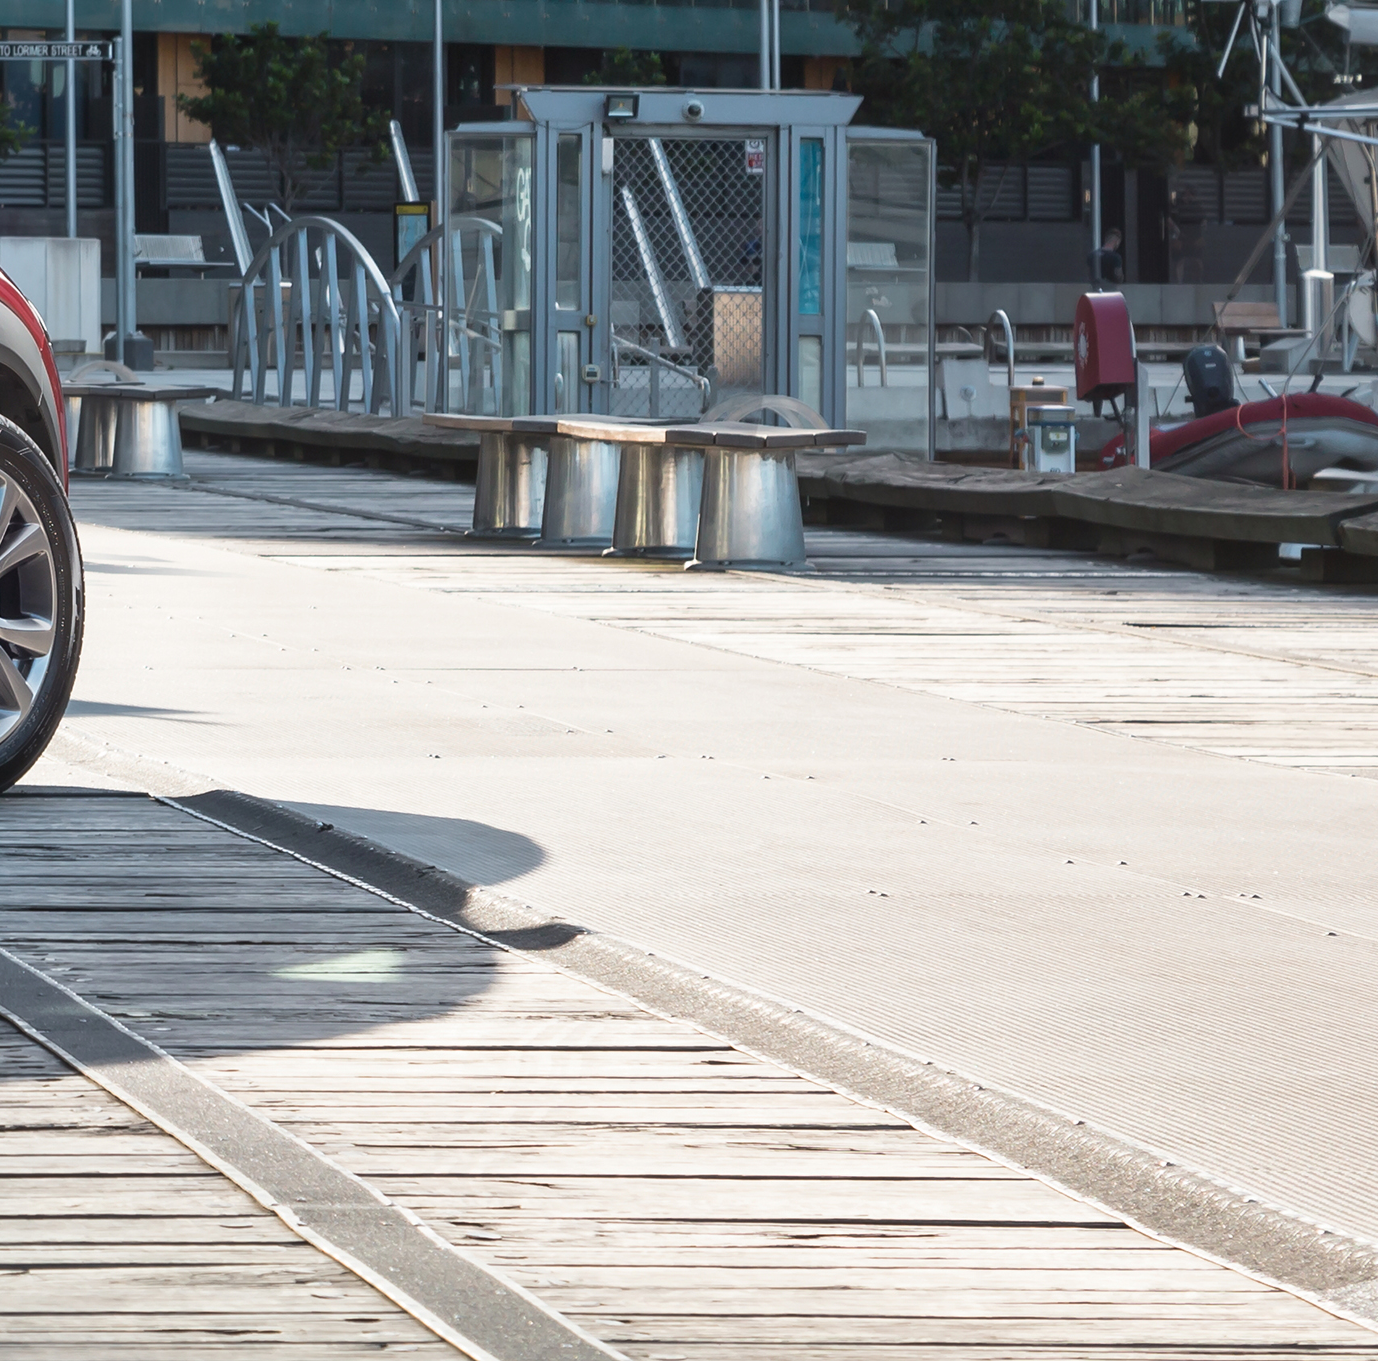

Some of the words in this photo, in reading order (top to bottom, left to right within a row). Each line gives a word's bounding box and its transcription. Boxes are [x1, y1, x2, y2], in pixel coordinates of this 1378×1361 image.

[0, 44, 11, 56] TO
[13, 44, 49, 56] LORIMER
[51, 44, 83, 56] STREET
